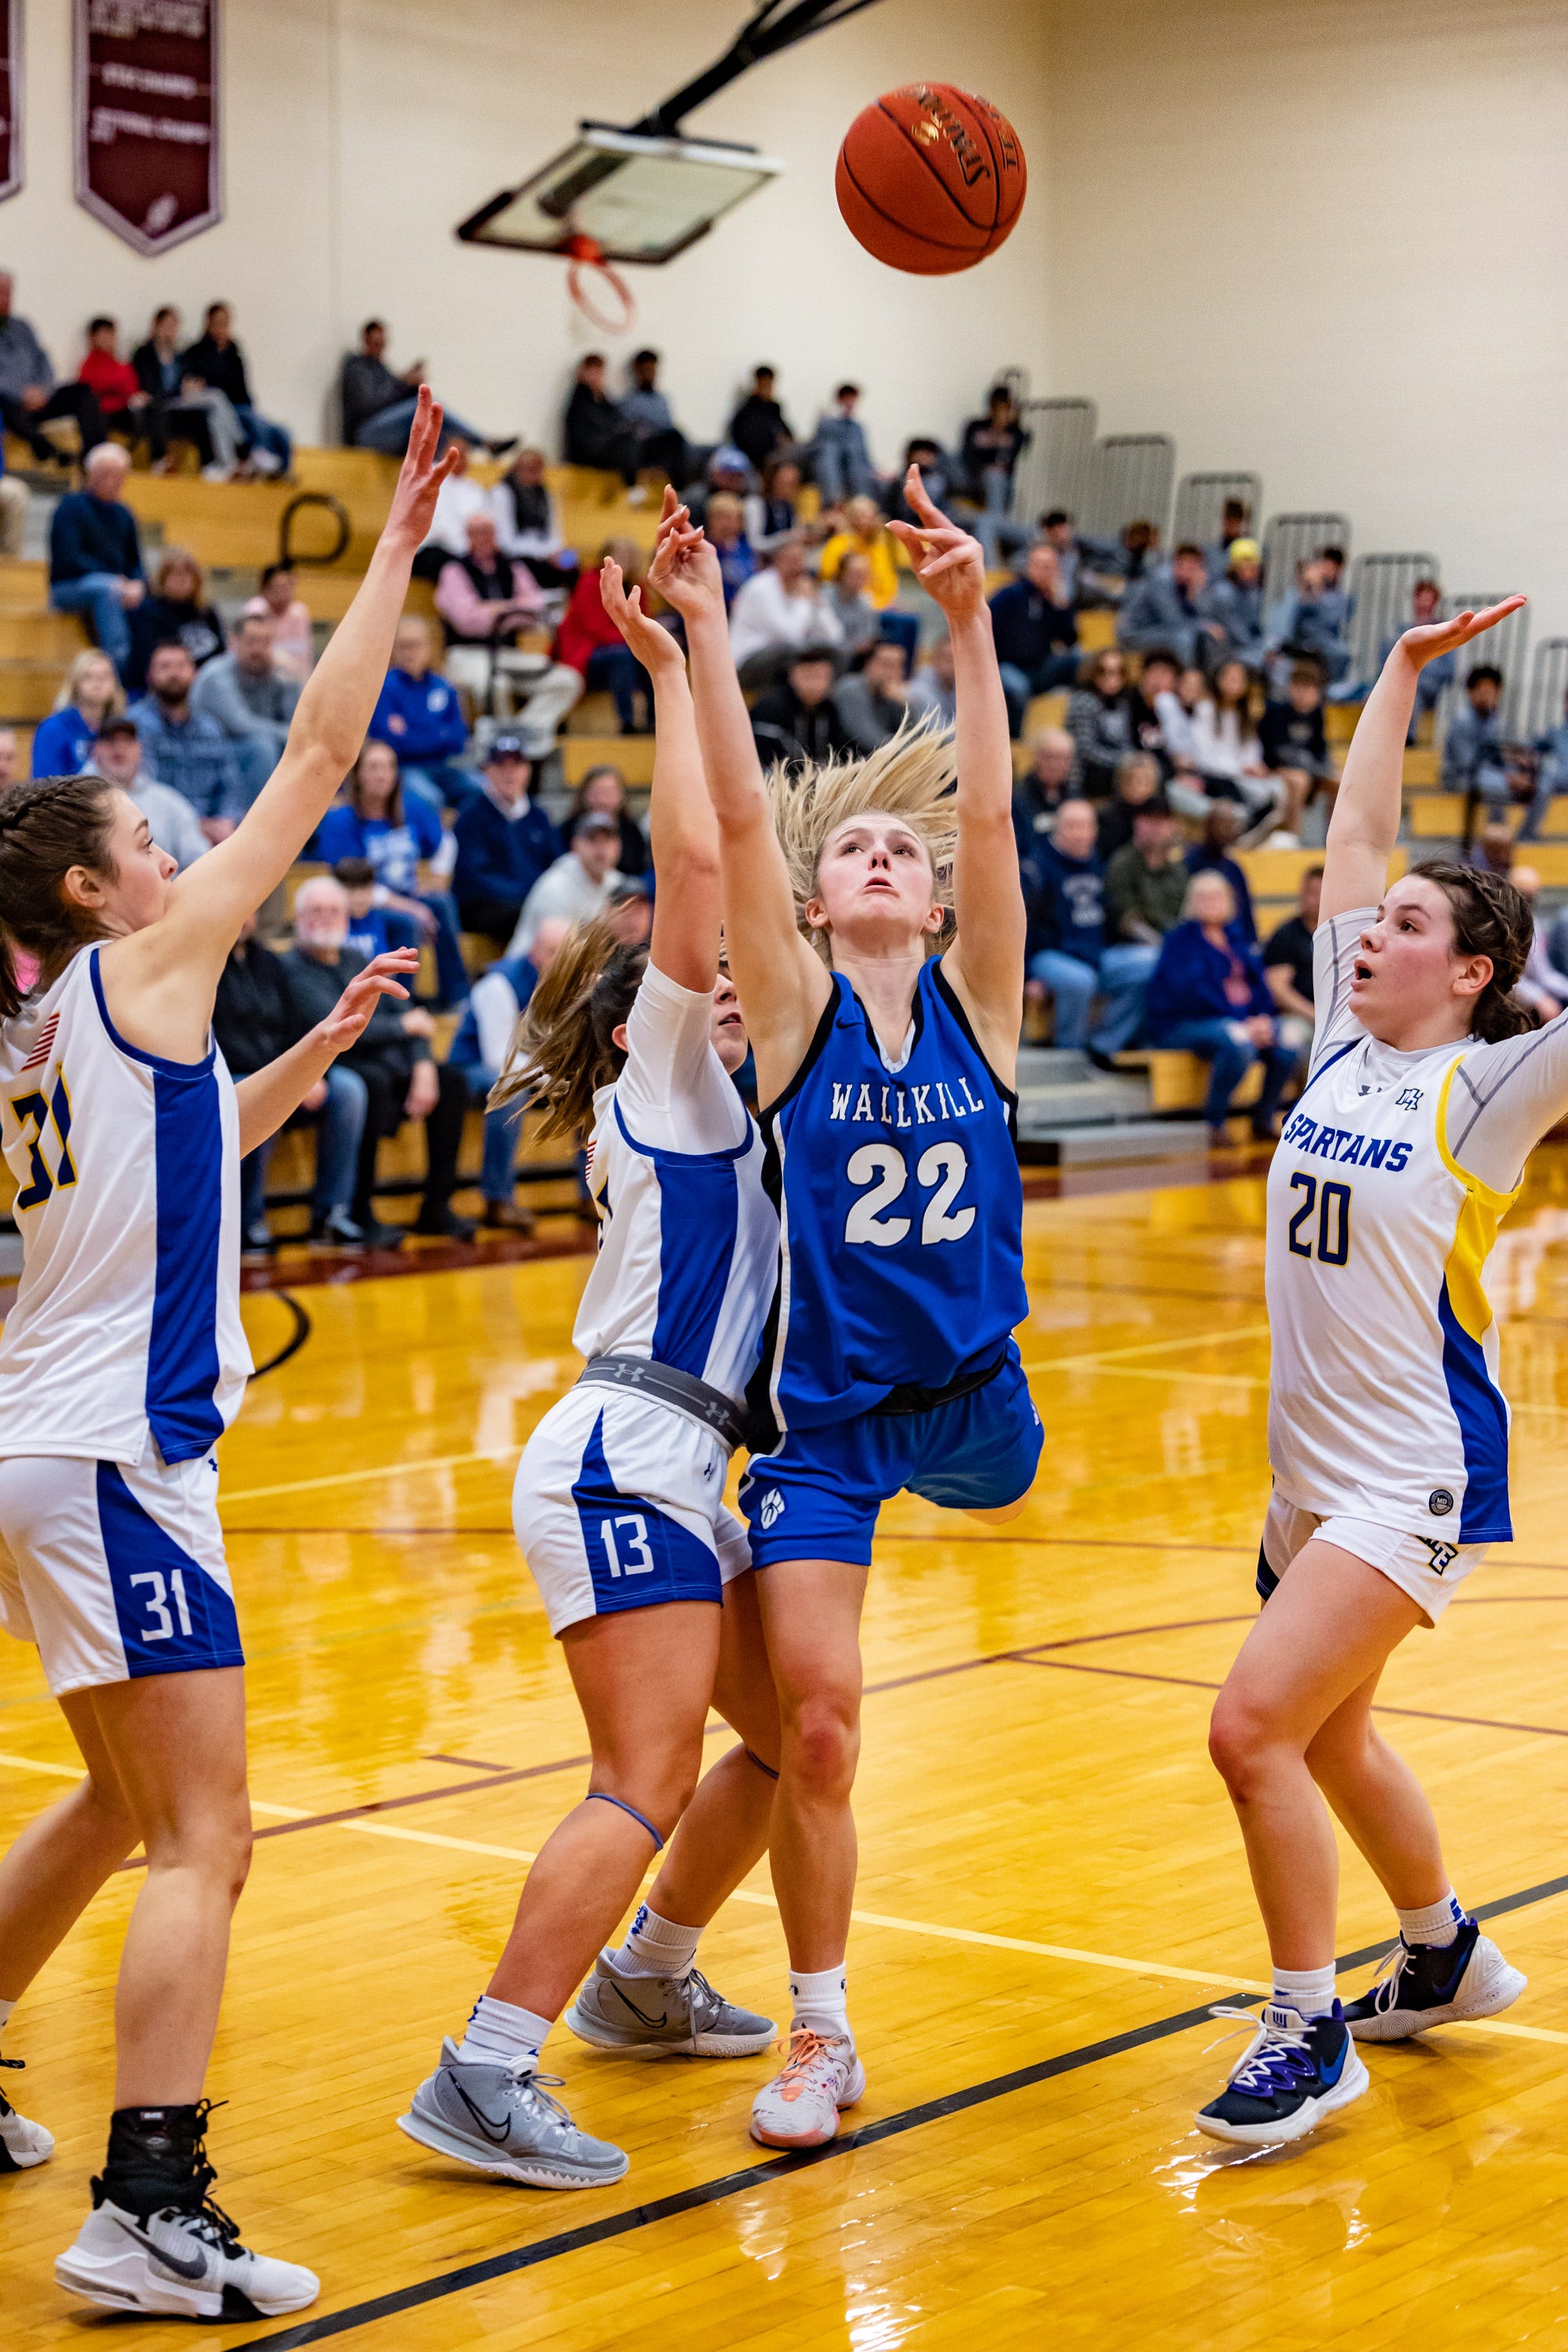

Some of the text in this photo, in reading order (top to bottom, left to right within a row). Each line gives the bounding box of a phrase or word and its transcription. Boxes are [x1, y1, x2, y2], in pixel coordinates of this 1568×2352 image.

[829, 1076, 984, 1127] WALLKILL
[1283, 1112, 1414, 1172] SPARTANS
[844, 1142, 976, 1247] 22
[1288, 1169, 1354, 1268] 20
[601, 1513, 655, 1577] 13
[129, 1569, 193, 1642] 31
